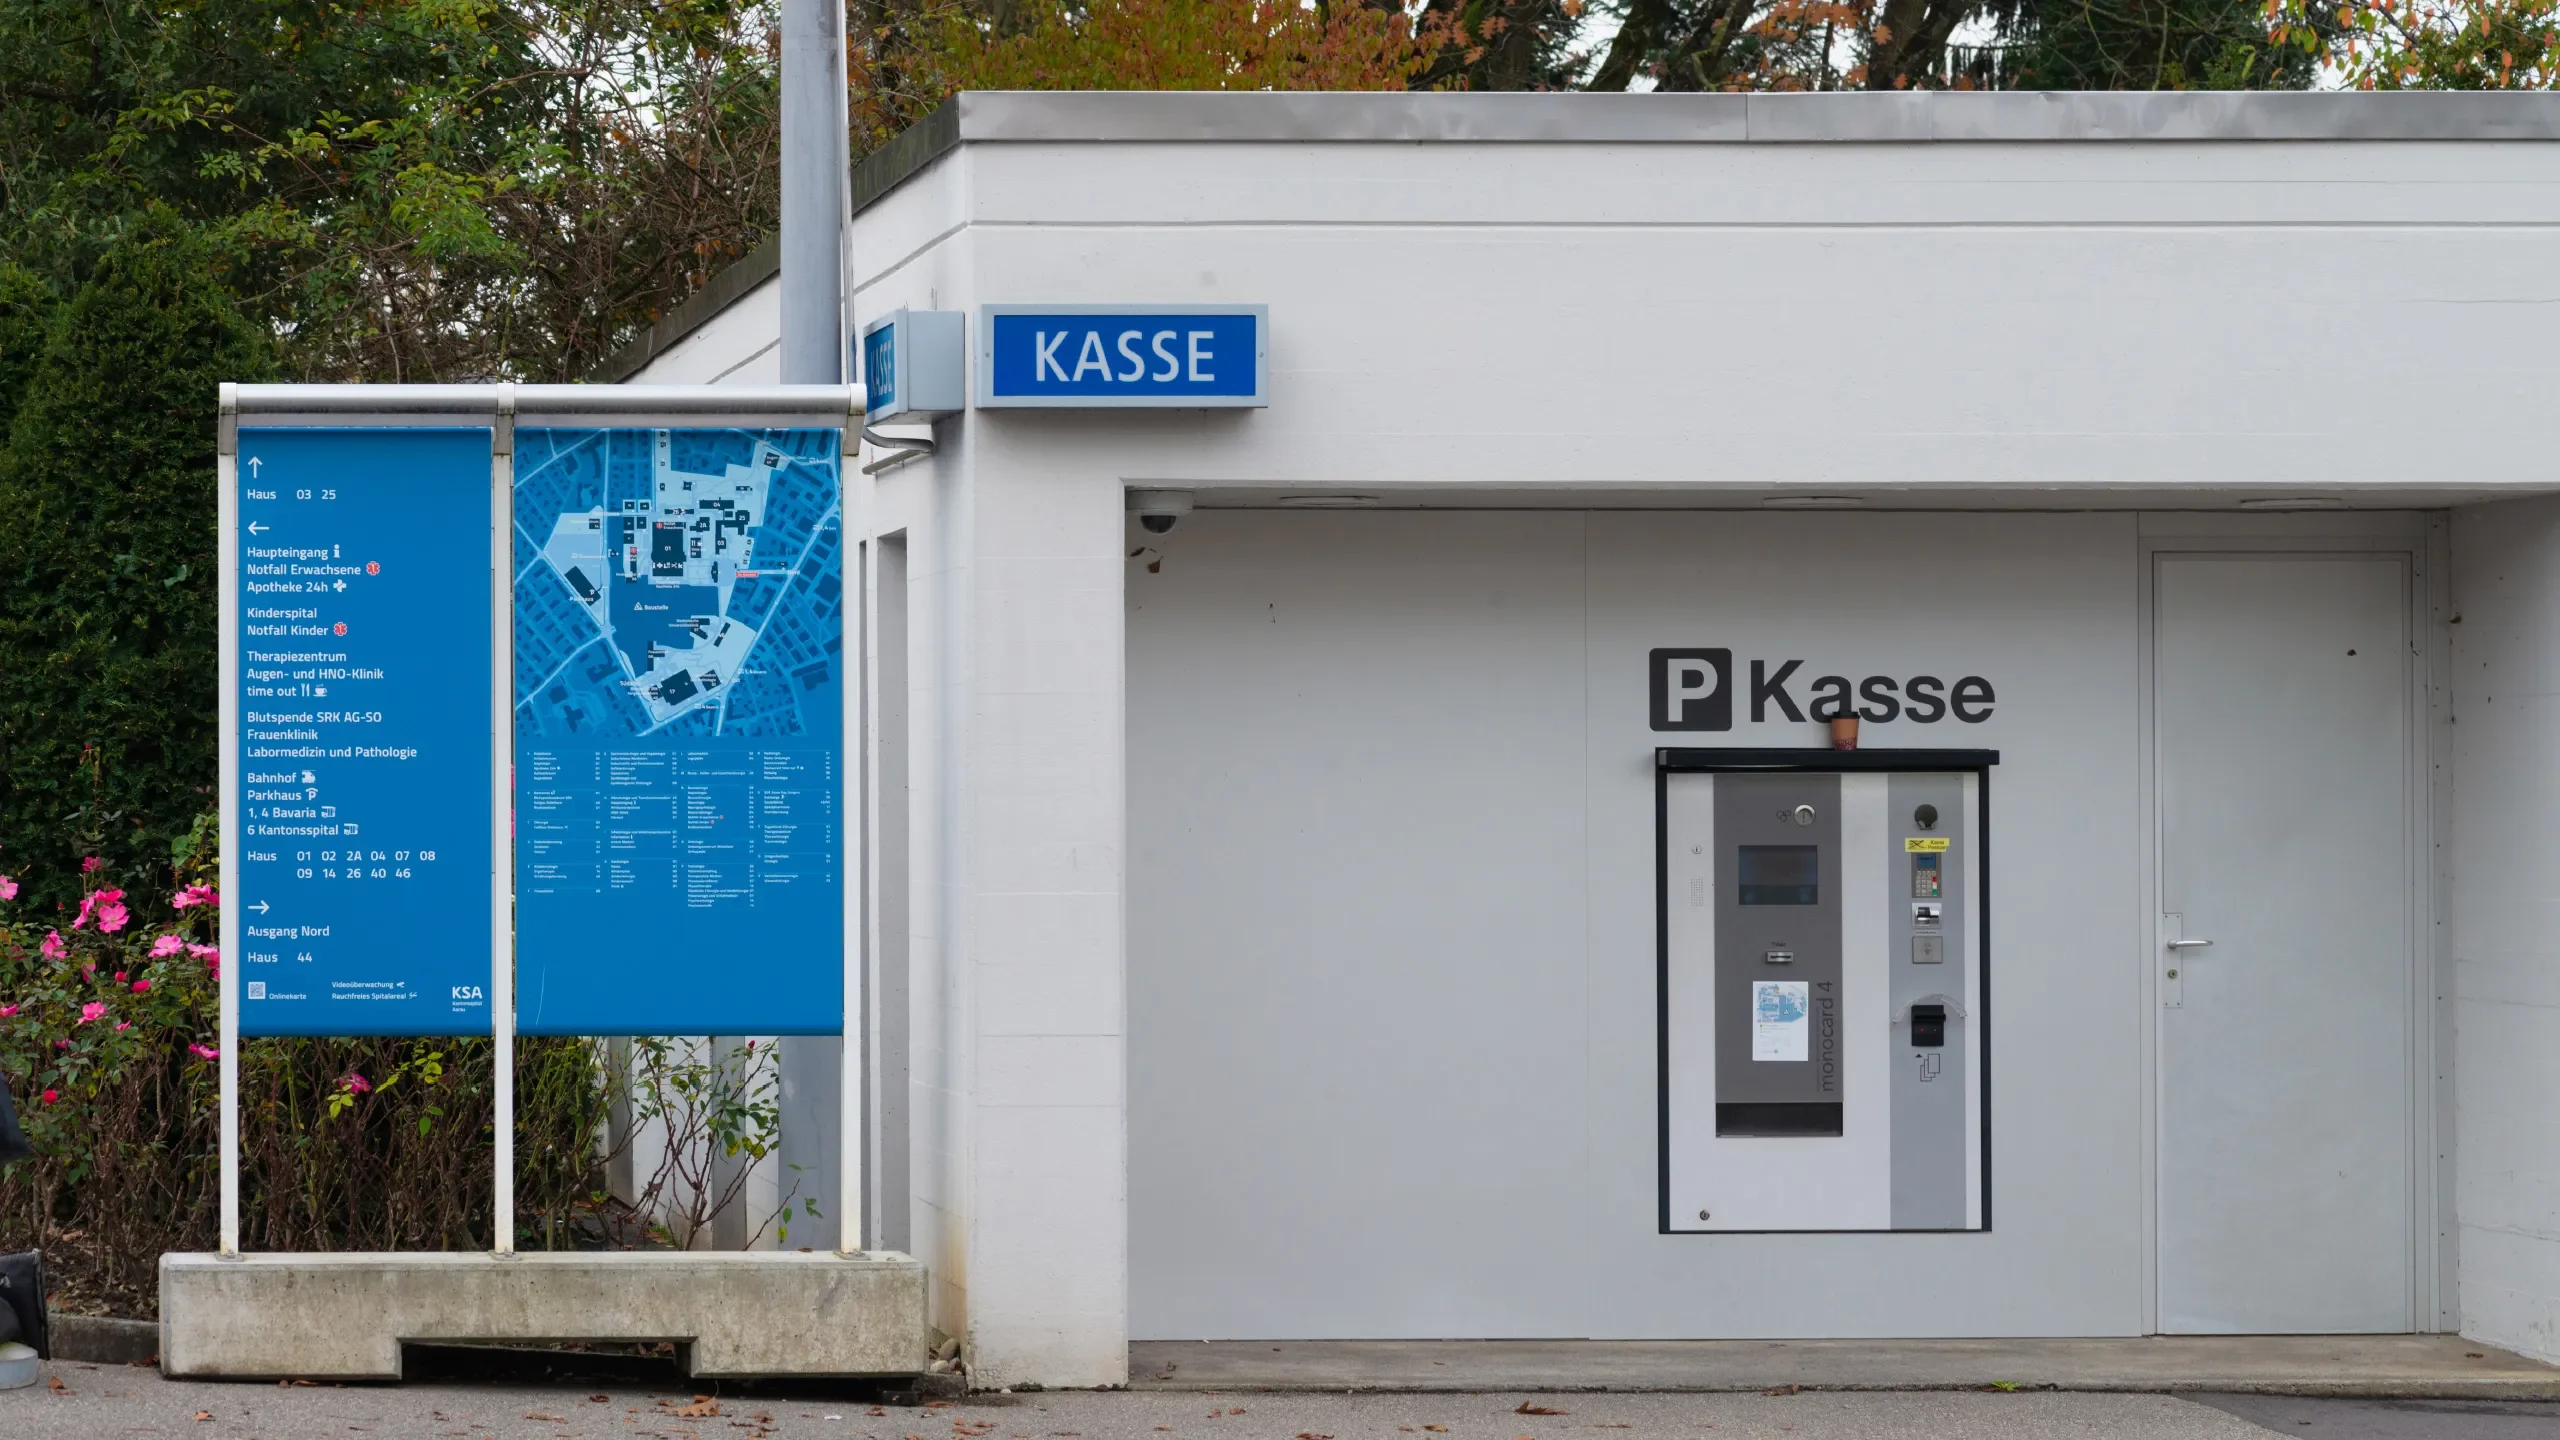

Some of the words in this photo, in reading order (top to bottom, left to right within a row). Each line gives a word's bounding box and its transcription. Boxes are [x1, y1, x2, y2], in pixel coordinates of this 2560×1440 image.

[1035, 330, 1215, 382] KASSE
[870, 340, 893, 398] KASSE
[247, 489, 277, 500] Haus
[296, 489, 312, 500] 03
[321, 489, 337, 500] 25
[247, 546, 329, 561] Haupteingang
[247, 563, 287, 575] Notfall
[291, 563, 361, 575] Erwachsene
[247, 581, 303, 594] Apotheke
[305, 581, 329, 593] 24h
[247, 607, 318, 620] Kinderspital
[247, 624, 287, 636] Notfall
[291, 624, 329, 636] Kinder
[247, 650, 347, 664] Therapiezentrum
[247, 668, 289, 682] Augen-
[293, 668, 316, 680] und
[319, 668, 384, 680] HNO-Klinik
[247, 685, 274, 697] time
[277, 686, 297, 697] out
[1667, 658, 1718, 722] P
[1750, 659, 1996, 724] Kasse
[247, 711, 314, 725] Blutspende
[316, 711, 341, 723] SRK
[344, 711, 382, 723] AG-SO
[247, 728, 318, 740] Frauenklinik
[247, 746, 326, 758] Labormedizin
[329, 746, 352, 758] und
[355, 746, 418, 761] Pathologie
[247, 772, 297, 784] Bahnhof
[247, 789, 302, 801] Parkhaus
[248, 807, 257, 819] 1,
[261, 807, 269, 818] 4
[272, 807, 317, 818] Bavaria
[247, 825, 256, 836] 6
[258, 824, 339, 838] Kantonsspital
[247, 850, 277, 862] Haus
[296, 850, 311, 861] 01
[321, 850, 337, 861] 02
[346, 850, 362, 861] 2A
[370, 850, 386, 861] 04
[394, 850, 410, 861] 07
[419, 850, 436, 861] 08
[296, 868, 313, 879] 09
[322, 868, 337, 879] 14
[346, 868, 362, 879] 26
[370, 868, 387, 879] 40
[395, 868, 411, 879] 46
[247, 925, 298, 940] Ausgang
[301, 925, 330, 937] Nord
[247, 951, 278, 963] Haus
[297, 952, 313, 963] 44
[331, 981, 394, 989] Videoüberwachung
[1816, 980, 1834, 993] 4
[331, 992, 369, 1000] Rauchfreies
[371, 992, 407, 1001] Spitalareal
[452, 986, 483, 999] KSA
[1816, 997, 1834, 1092] monocard
